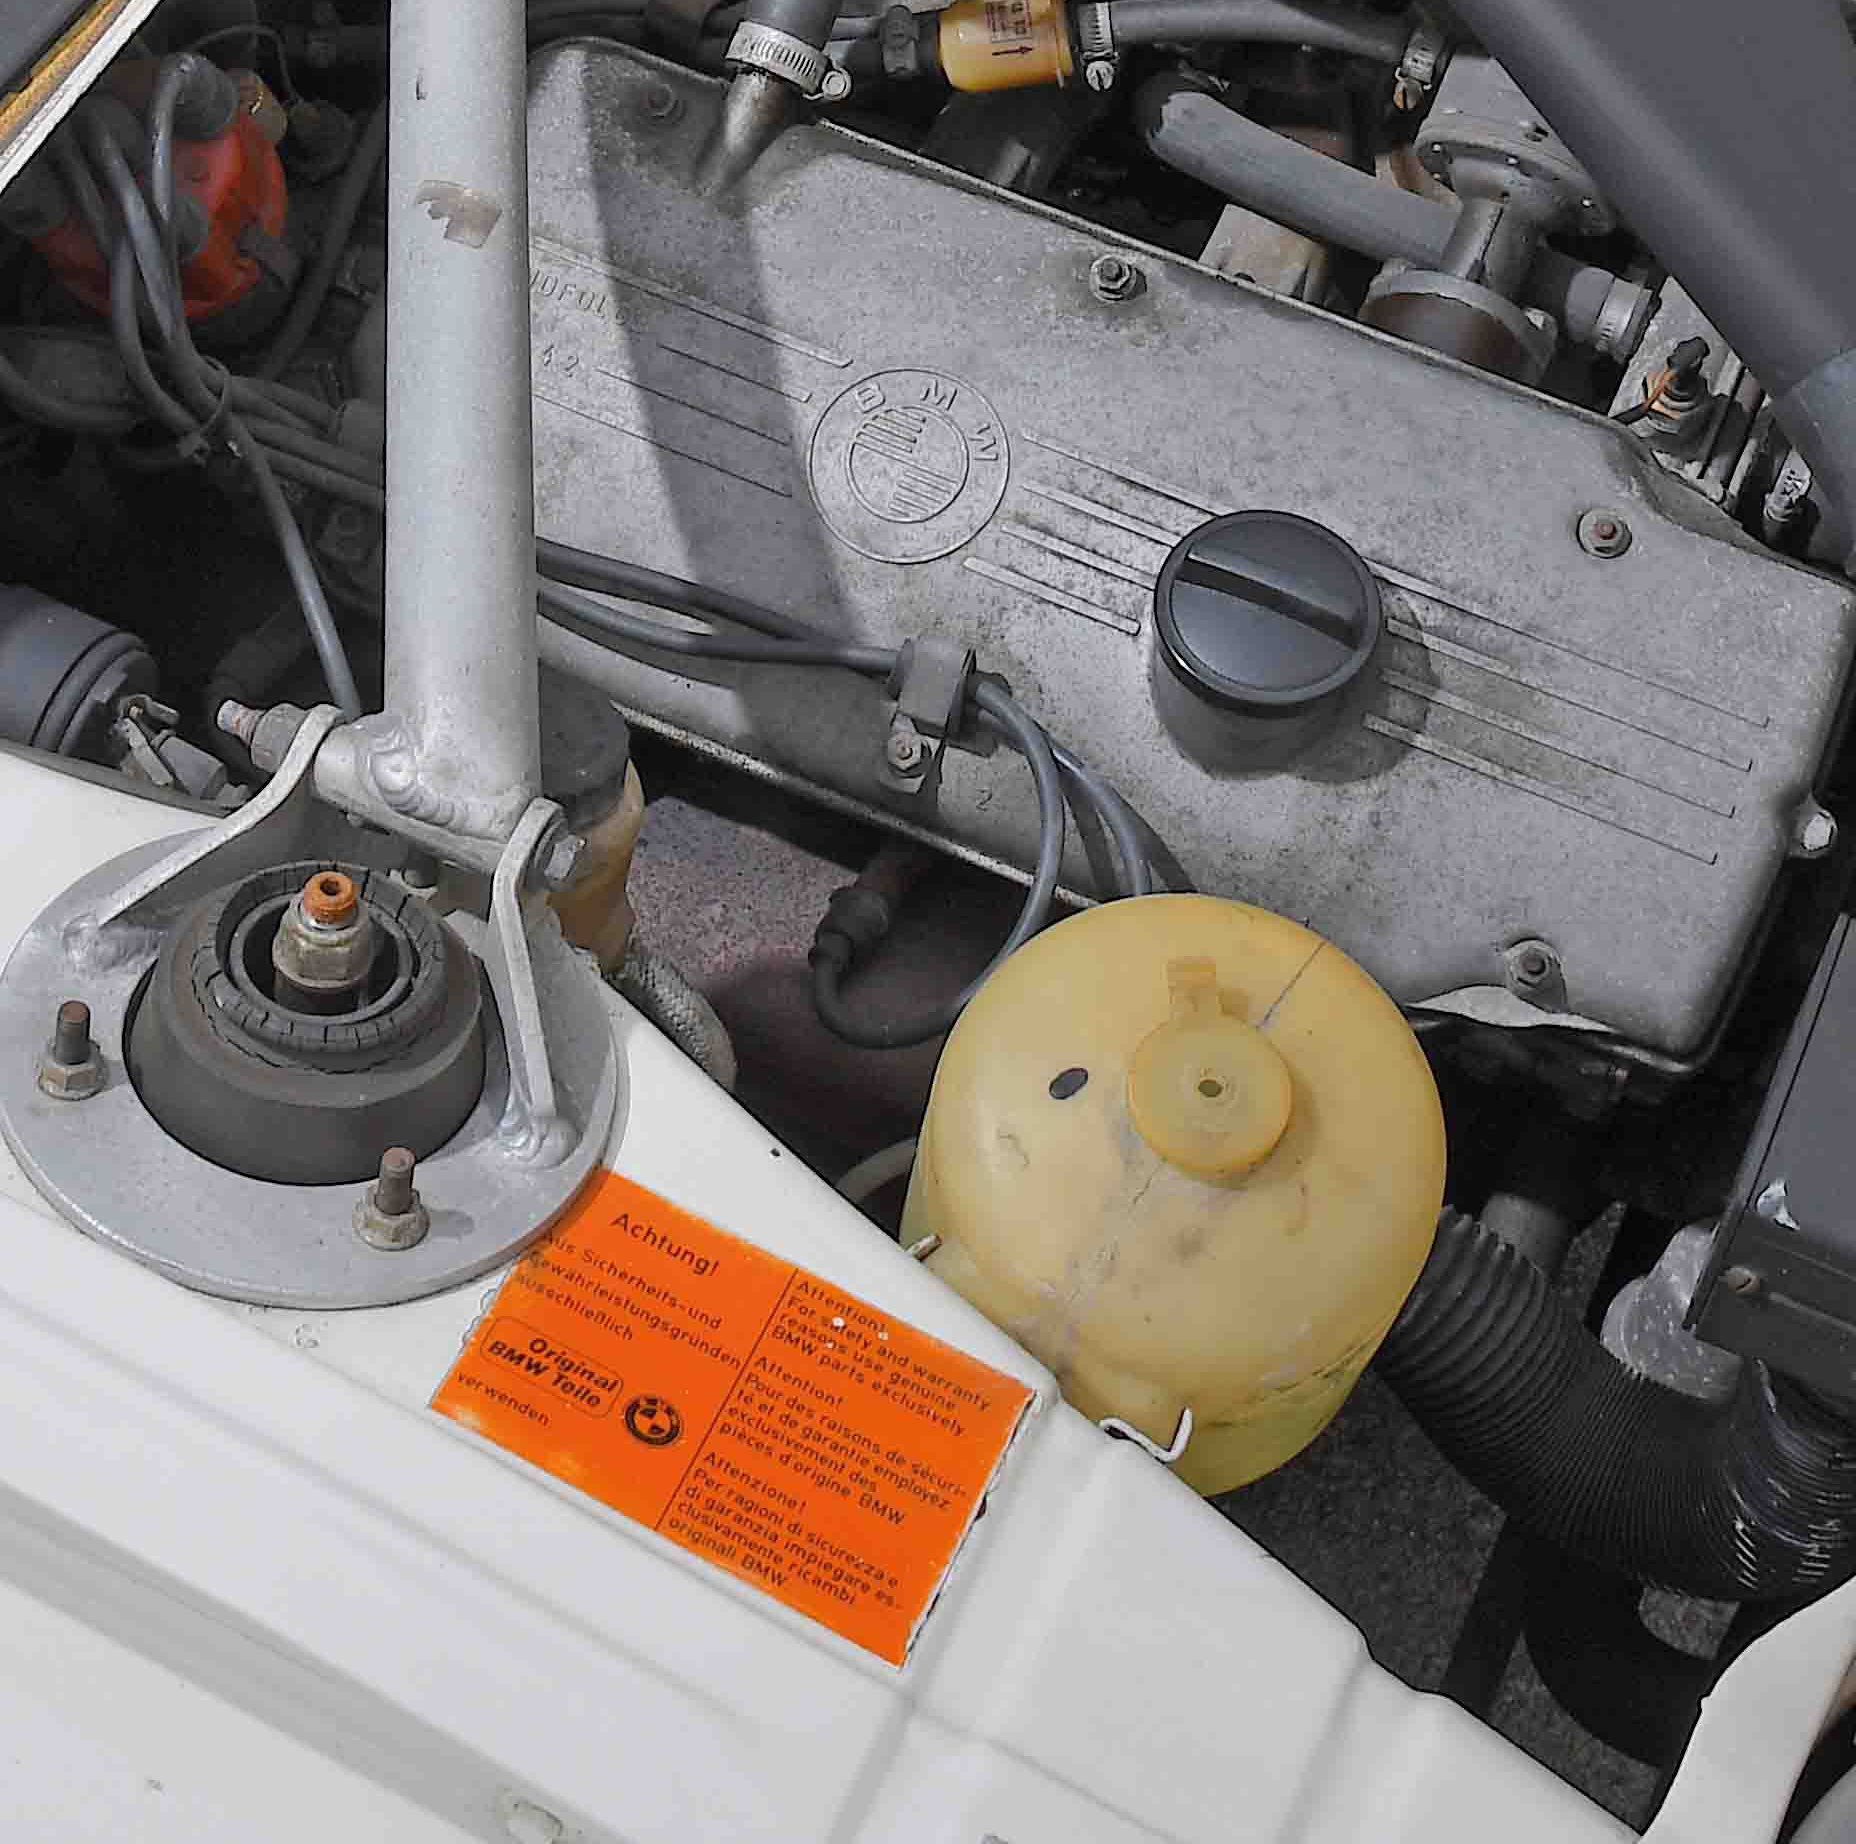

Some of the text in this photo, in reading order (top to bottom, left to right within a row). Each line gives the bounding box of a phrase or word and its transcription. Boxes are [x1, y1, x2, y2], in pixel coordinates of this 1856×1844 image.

[854, 378, 1000, 462] BMW
[610, 1212, 720, 1277] Achtung!
[488, 1340, 601, 1407] BMW Teile
[528, 1338, 619, 1393] Original
[753, 1355, 844, 1407] Attention!
[771, 1324, 966, 1437] BMW parts exclusively
[779, 1313, 957, 1411] reasons use genuine
[787, 1295, 817, 1319] For
[876, 1345, 910, 1368] and
[912, 1363, 991, 1412] warranty
[727, 1407, 877, 1493] exclusivement des
[736, 1388, 951, 1509] té et de garantie employez
[744, 1371, 784, 1401] Pour
[785, 1395, 815, 1420] des
[819, 1415, 881, 1455] raisons
[885, 1451, 907, 1466] de
[702, 1451, 807, 1512] Attenzione!
[719, 1421, 774, 1458] pièces
[858, 1492, 905, 1525] BMW
[668, 1517, 788, 1587] originali BMW
[677, 1502, 857, 1605] clusivamente ricambi
[684, 1485, 703, 1501] di
[702, 1498, 779, 1544] garanzia
[783, 1541, 872, 1594] impiegare
[692, 1467, 724, 1493] Per
[727, 1488, 785, 1526] ragioni
[786, 1521, 802, 1537] di
[806, 1532, 885, 1581] sicurezza
